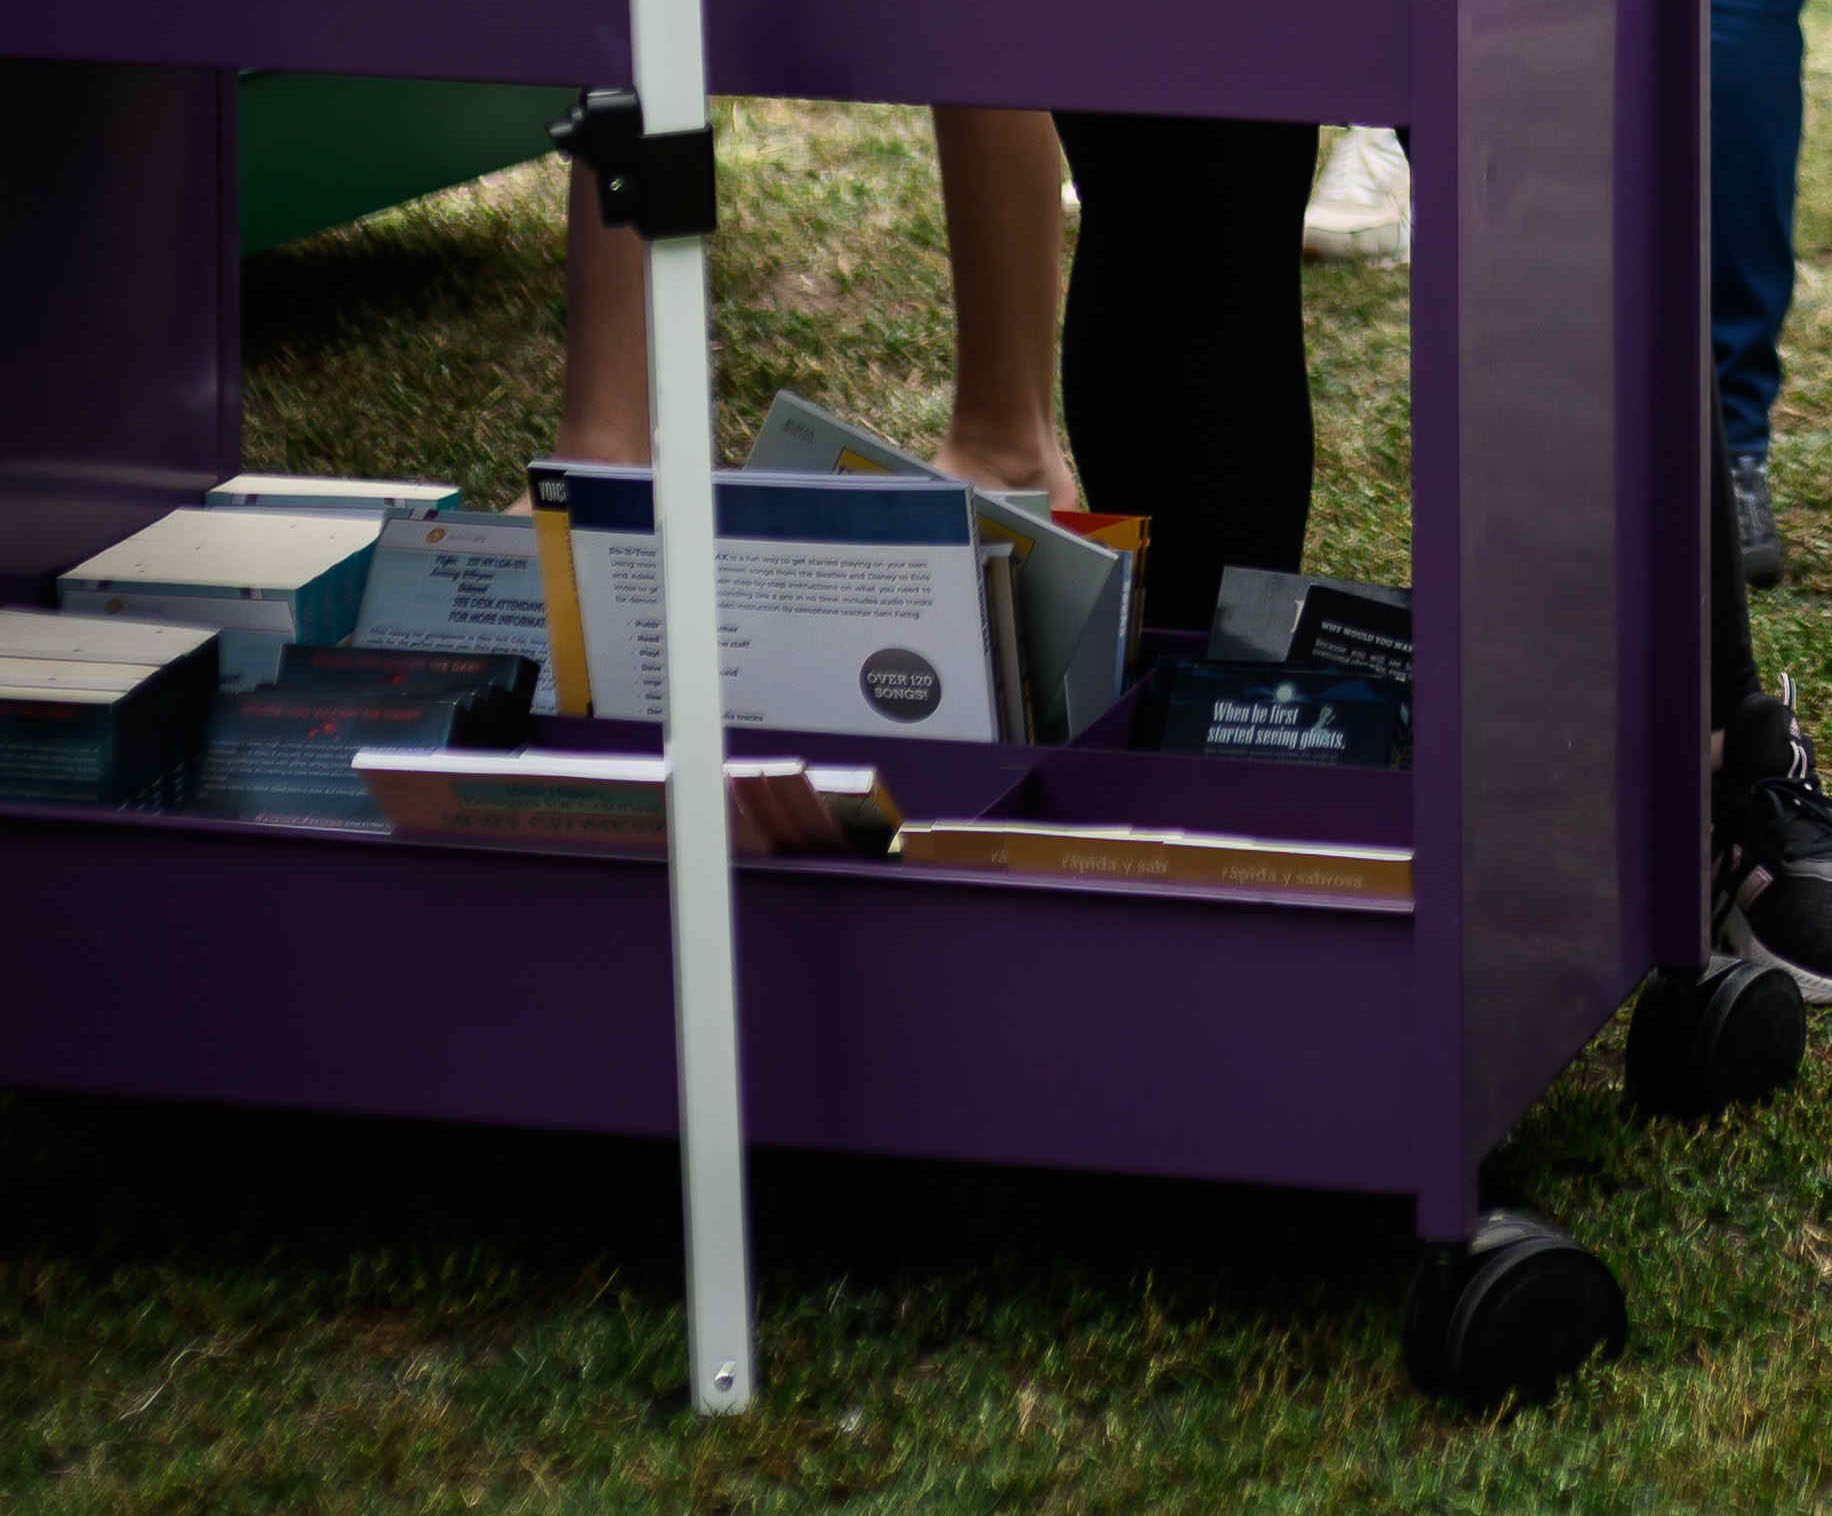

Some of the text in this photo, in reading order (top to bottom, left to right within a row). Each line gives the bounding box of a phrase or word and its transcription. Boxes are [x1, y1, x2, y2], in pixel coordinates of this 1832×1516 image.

[867, 672, 933, 687] OVER 120
[874, 687, 928, 702] SONGS!
[1213, 699, 1299, 726] When he first
[1207, 724, 1346, 750] started seeing ghosts.
[1062, 854, 1116, 874] rápida
[1222, 865, 1363, 889] rápida y sabrosa
